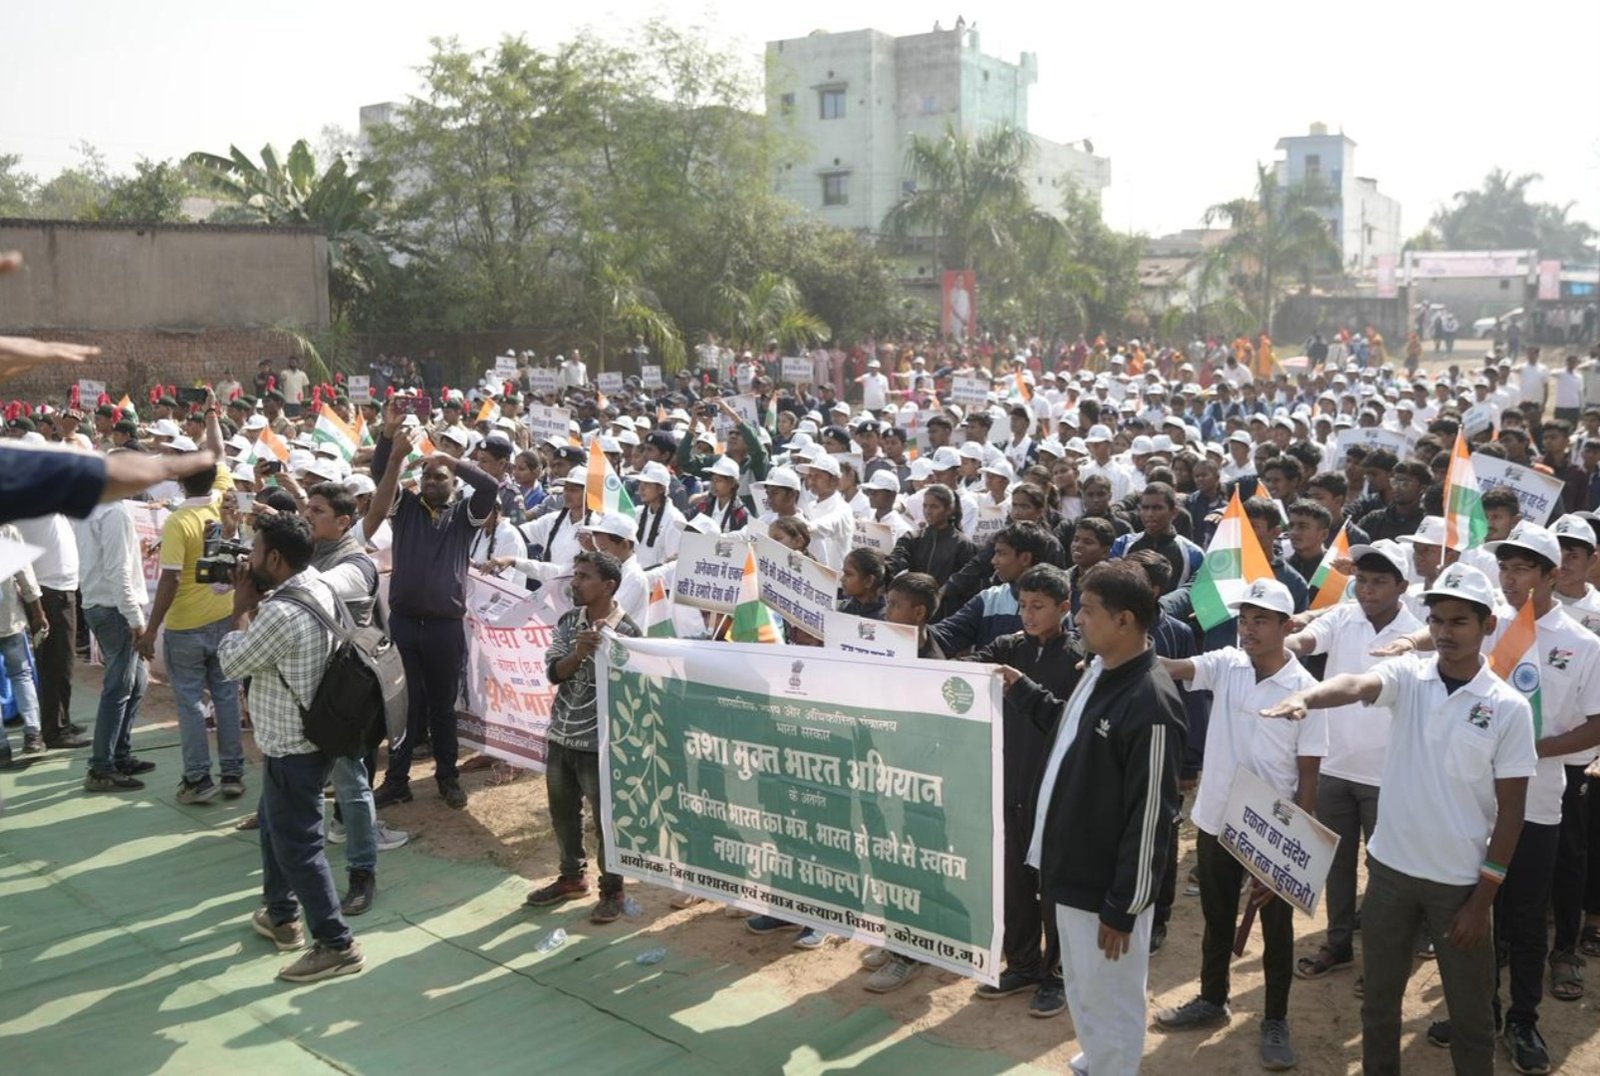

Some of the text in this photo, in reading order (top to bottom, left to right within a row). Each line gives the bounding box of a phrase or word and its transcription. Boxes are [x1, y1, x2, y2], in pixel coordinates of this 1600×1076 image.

[776, 722, 831, 741] भारत सरकार
[683, 731, 943, 807] नशा मुक्त भारत अभियान
[788, 786, 799, 801] के
[677, 782, 727, 821] विकसित
[728, 803, 761, 830] भारत
[761, 811, 782, 834] का
[816, 822, 851, 852] भारत
[854, 824, 869, 859] हो
[872, 831, 898, 864] नशे
[901, 835, 917, 868] से
[919, 845, 968, 880] स्वतंत्र
[713, 834, 794, 880] नशामुक्ति
[1223, 822, 1237, 845] हर
[1236, 831, 1256, 861] दिल
[1254, 850, 1273, 874] तक
[1243, 805, 1311, 870] एकता का संदेश
[697, 873, 739, 894] प्रशासन
[740, 885, 757, 900] एवं
[759, 892, 794, 910] समाज
[796, 900, 843, 924] कल्याण
[894, 927, 935, 951] कोरबा
[937, 941, 984, 969] (छ.ग.)
